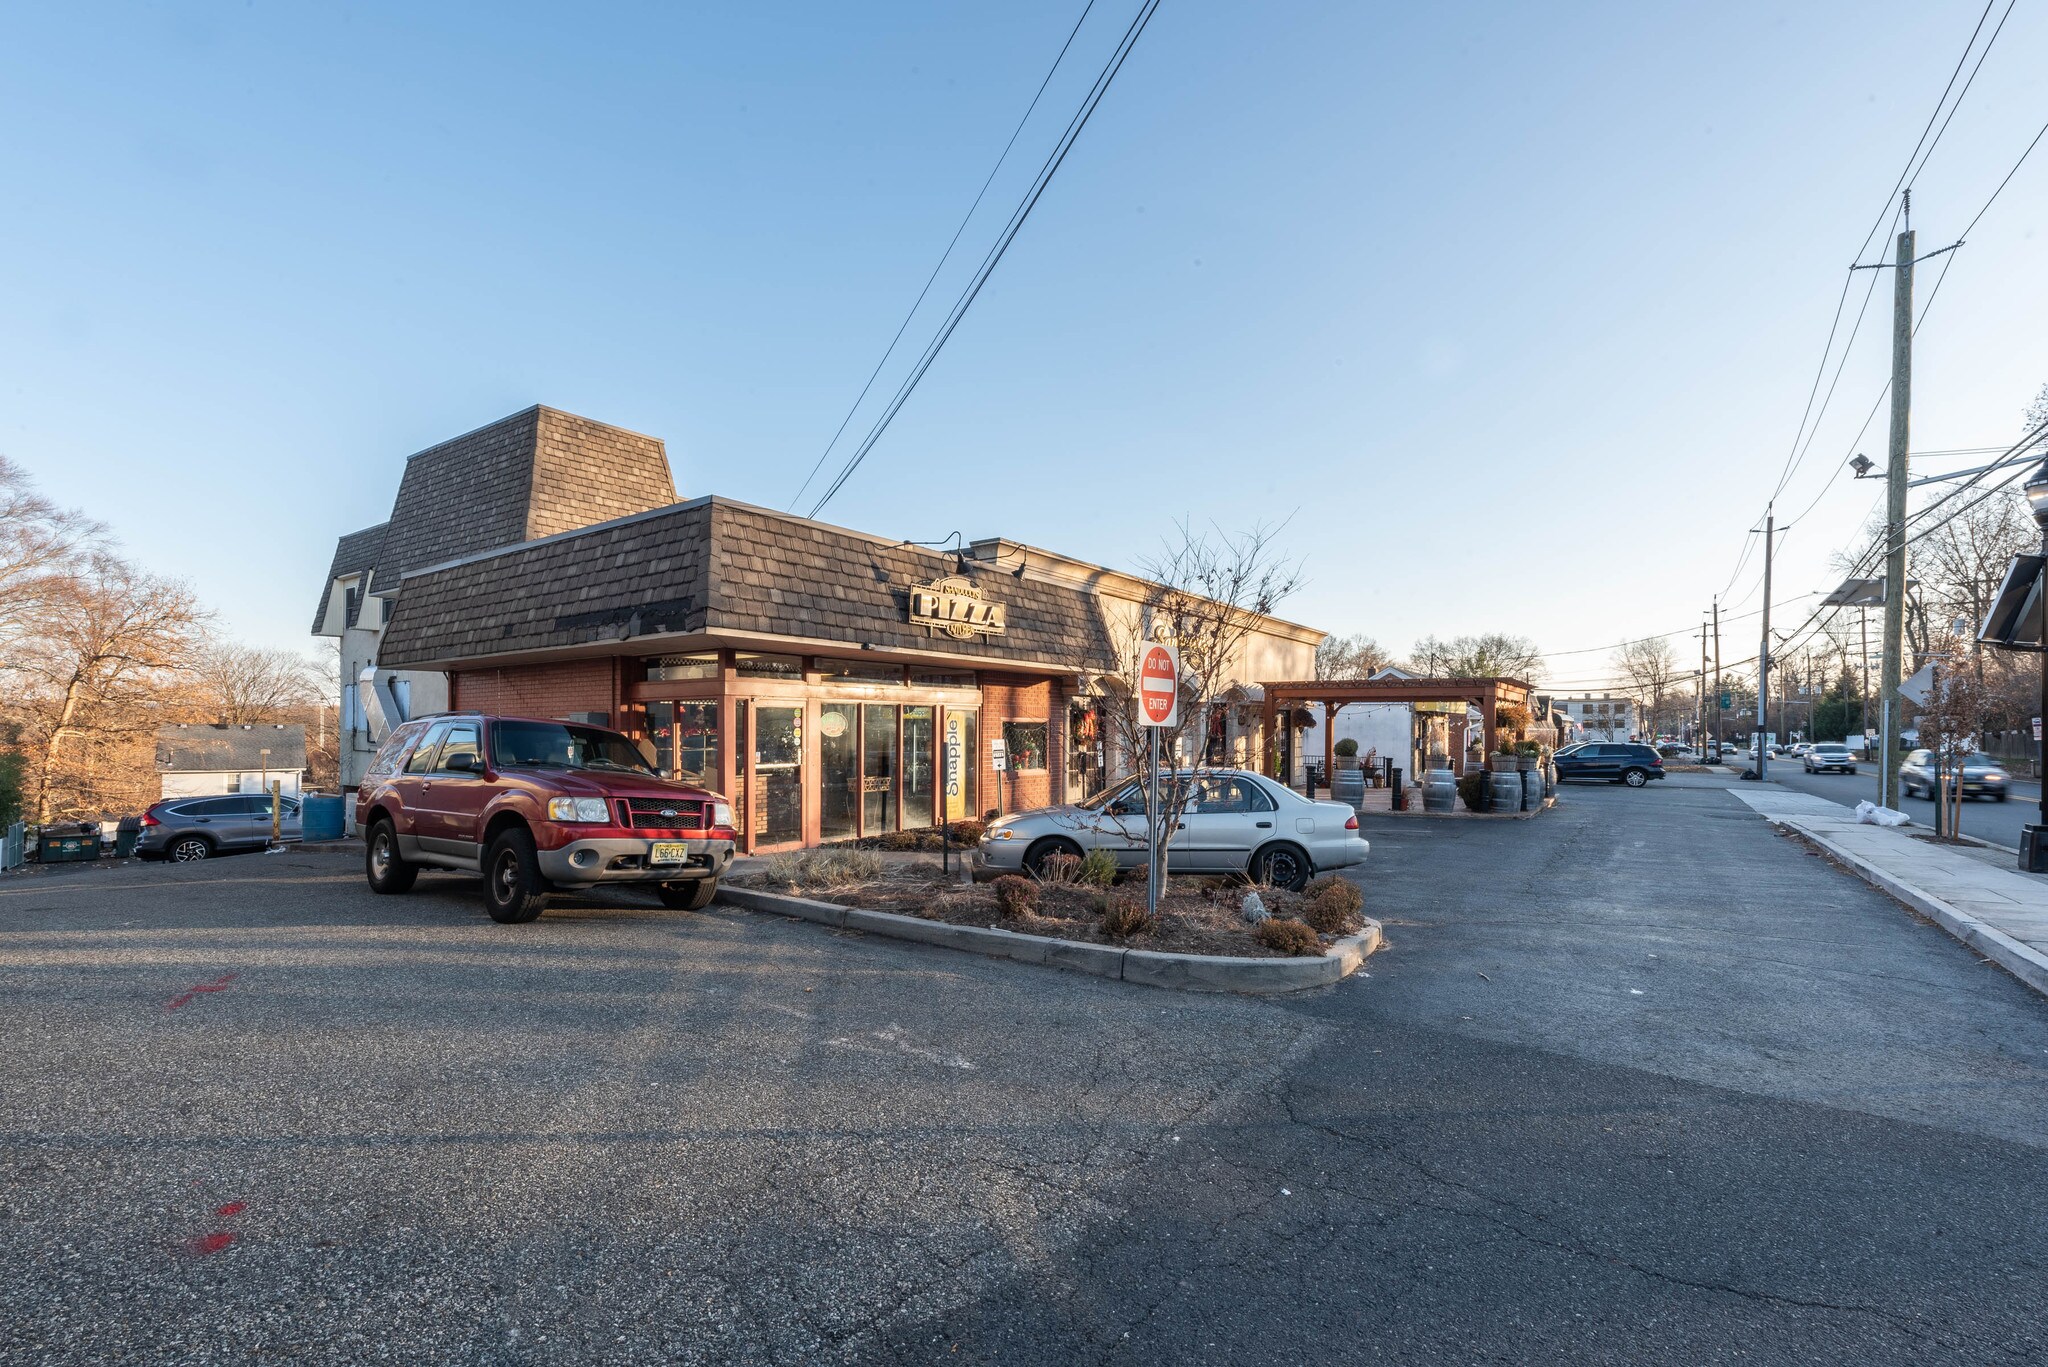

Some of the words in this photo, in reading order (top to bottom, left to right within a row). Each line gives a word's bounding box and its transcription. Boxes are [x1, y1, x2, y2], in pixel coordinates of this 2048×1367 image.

[916, 593, 1006, 628] PIZZA
[1148, 657, 1157, 670] DO
[1158, 659, 1170, 671] NOT
[1149, 698, 1168, 710] ENTER
[946, 720, 961, 796] Snapple
